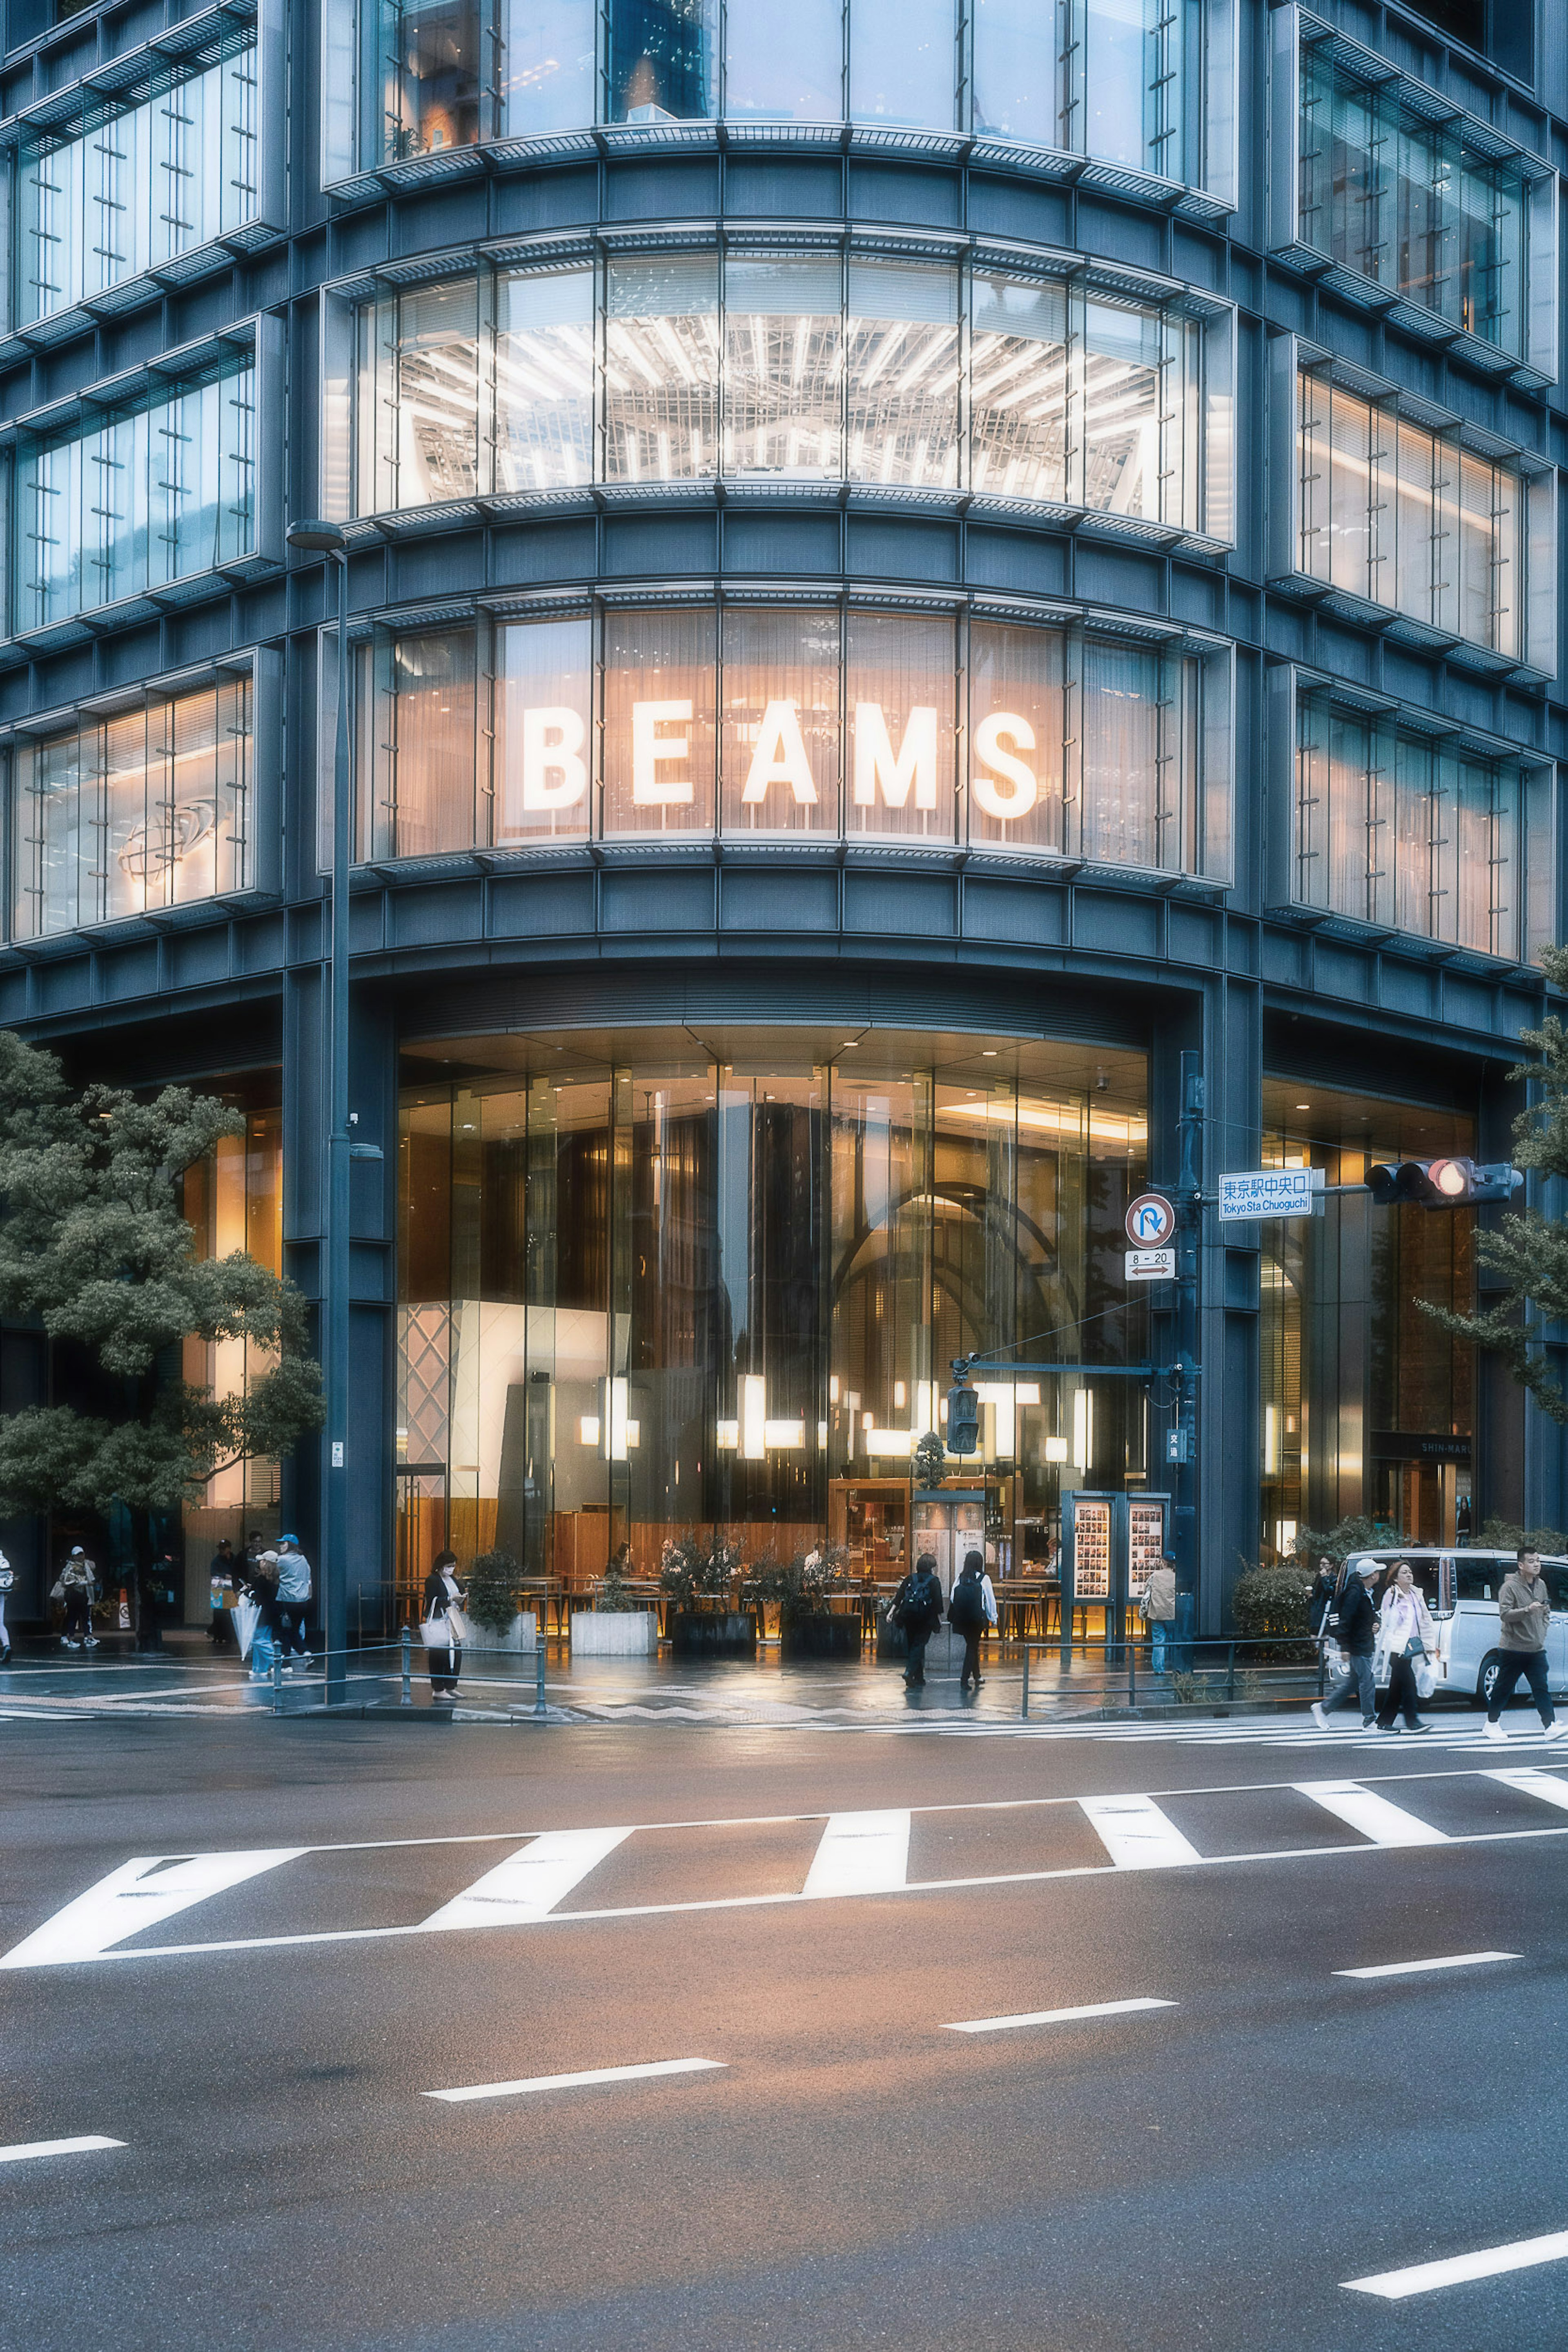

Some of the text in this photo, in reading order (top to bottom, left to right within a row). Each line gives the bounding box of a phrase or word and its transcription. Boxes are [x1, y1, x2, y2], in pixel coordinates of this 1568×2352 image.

[523, 699, 1038, 820] BEAMS
[1223, 1176, 1305, 1200] 東京駅中央口
[1223, 1203, 1246, 1215] Tokyo
[1263, 1197, 1307, 1211] Chuoguchi
